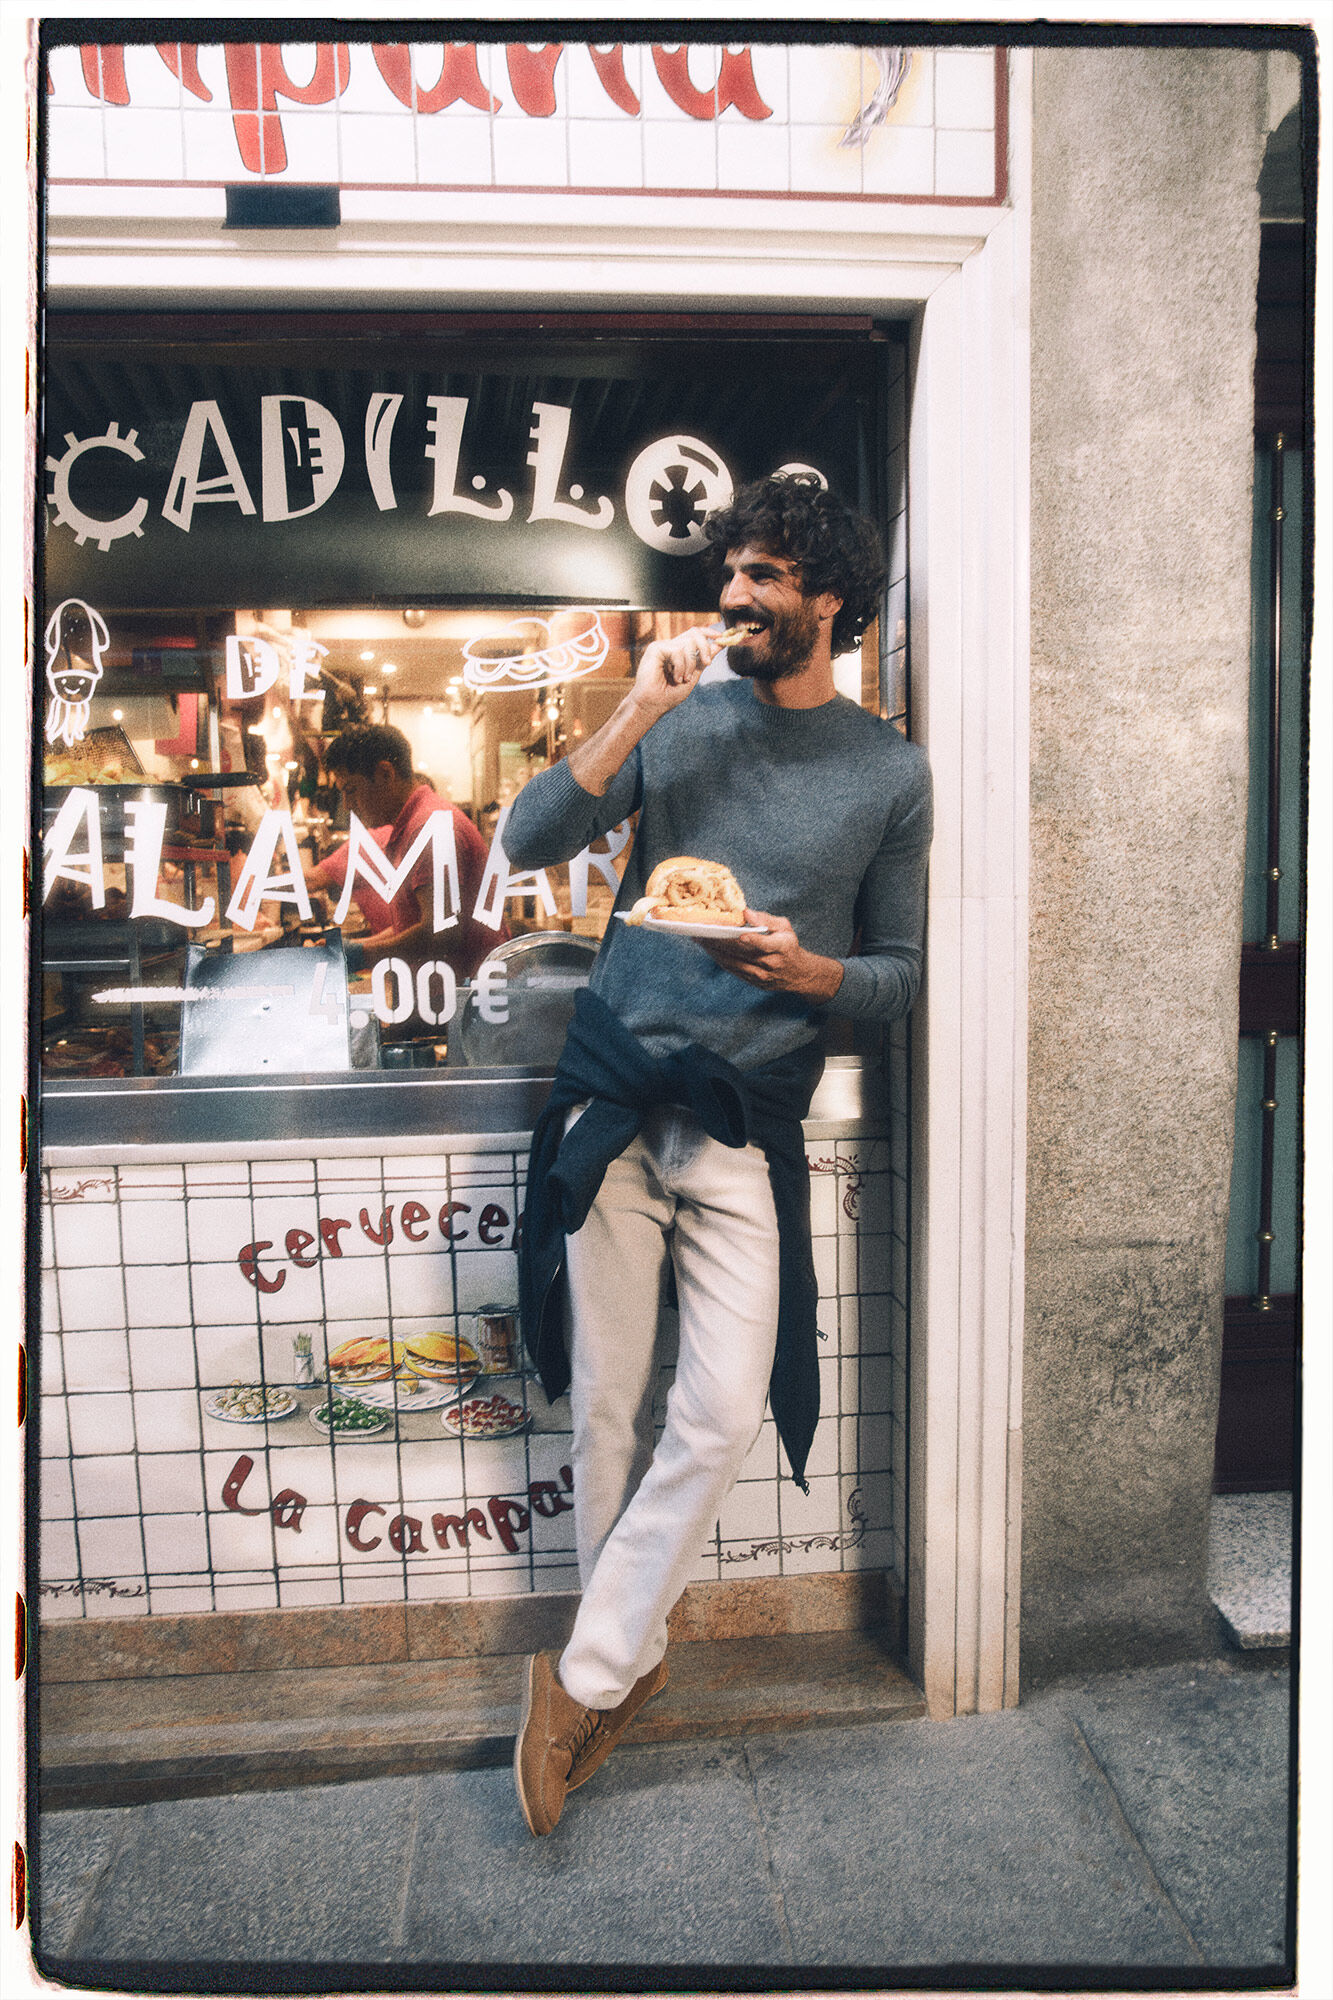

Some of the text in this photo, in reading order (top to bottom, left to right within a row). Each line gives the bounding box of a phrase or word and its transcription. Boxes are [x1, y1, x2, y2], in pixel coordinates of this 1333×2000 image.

[45, 393, 829, 556] CADILLO
[226, 635, 330, 700] DE
[222, 1455, 574, 1552] La Campa
